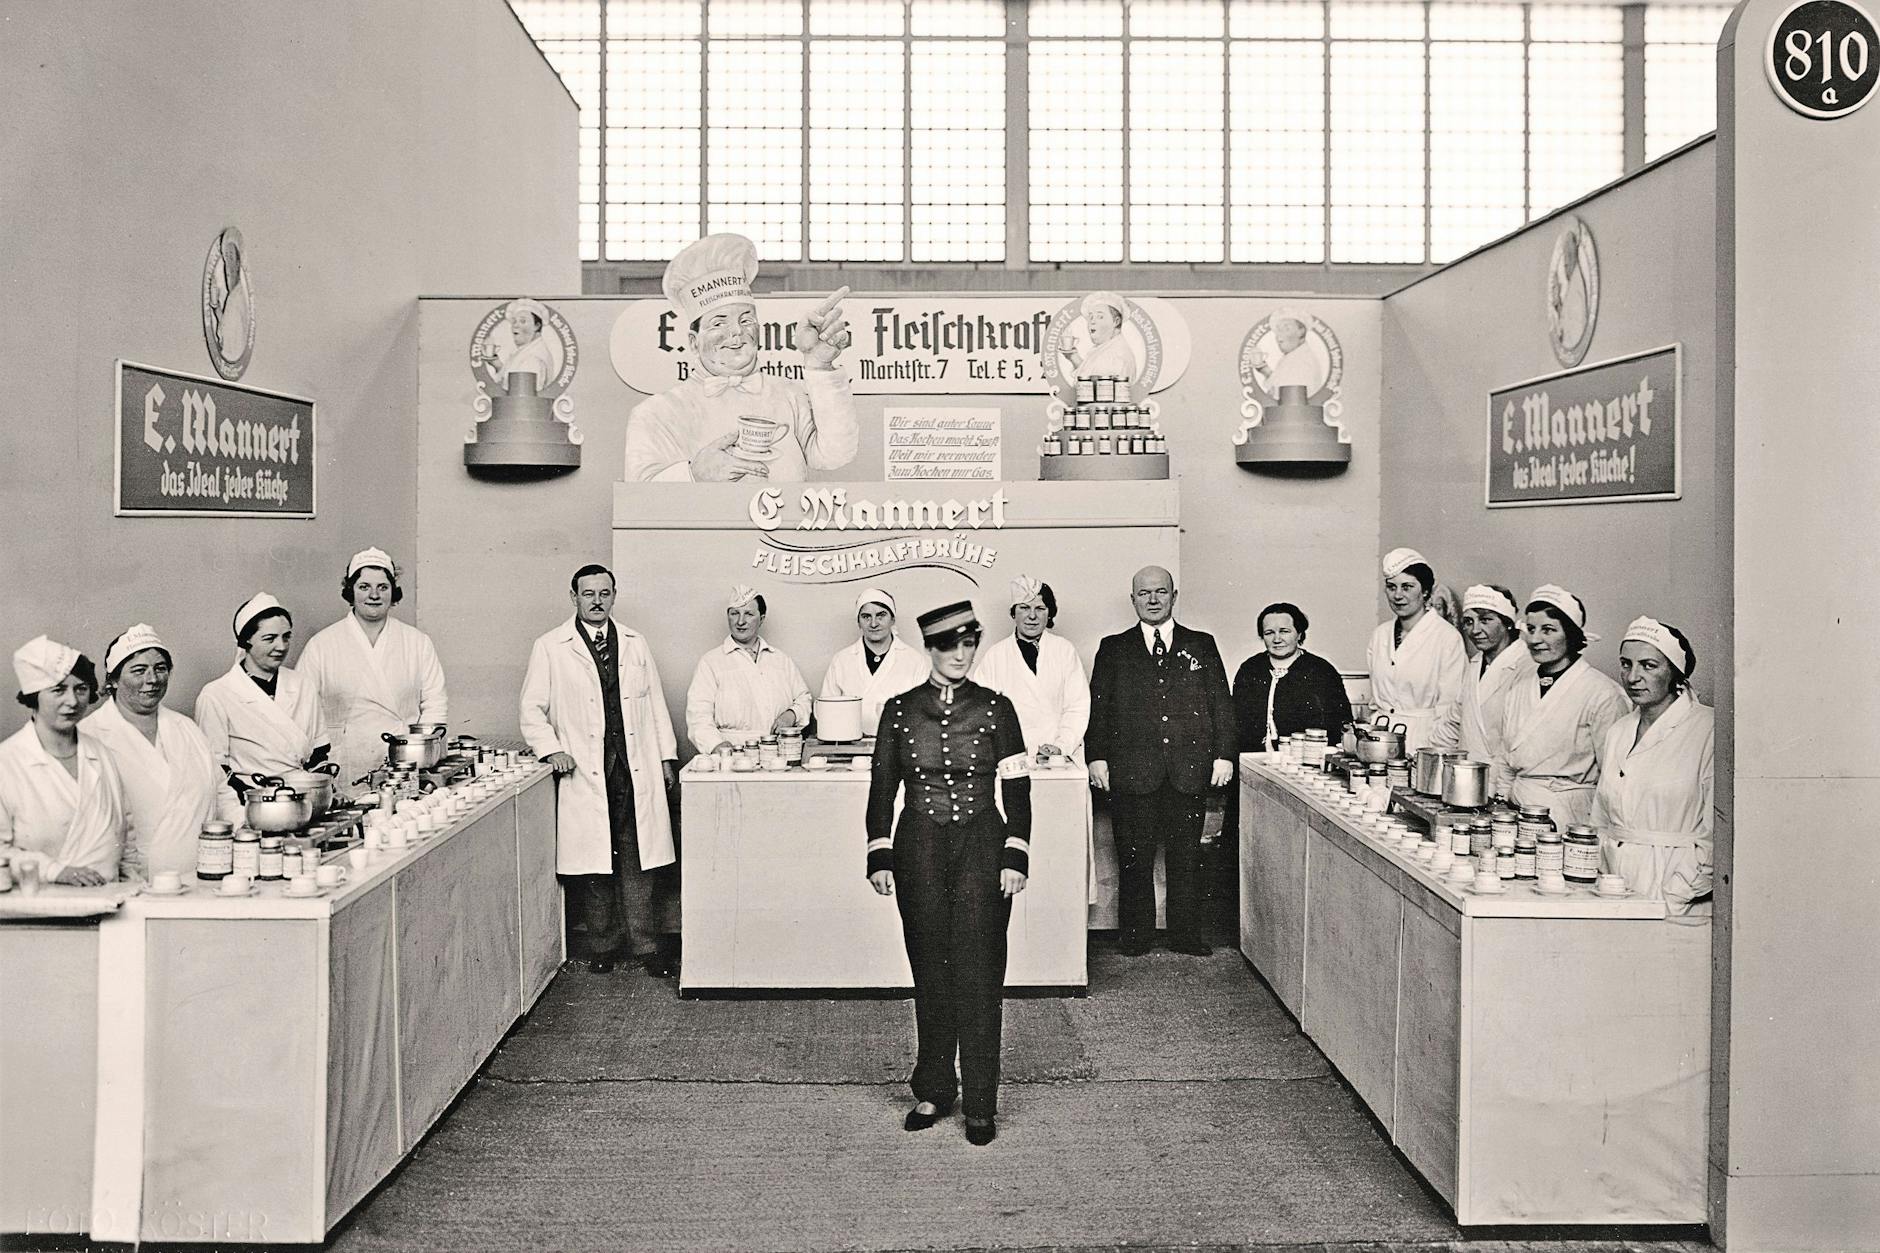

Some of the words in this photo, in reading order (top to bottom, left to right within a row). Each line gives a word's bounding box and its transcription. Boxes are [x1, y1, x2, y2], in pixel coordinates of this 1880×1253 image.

[1785, 30, 1868, 83] 810
[1821, 87, 1839, 104] a
[889, 416, 910, 427] Wir
[161, 459, 185, 497] das
[222, 467, 253, 504] jeder
[1559, 452, 1588, 492] jeder
[797, 487, 1009, 530] Mannert
[752, 534, 998, 576] FLEISCHKRAFTBRÜHE
